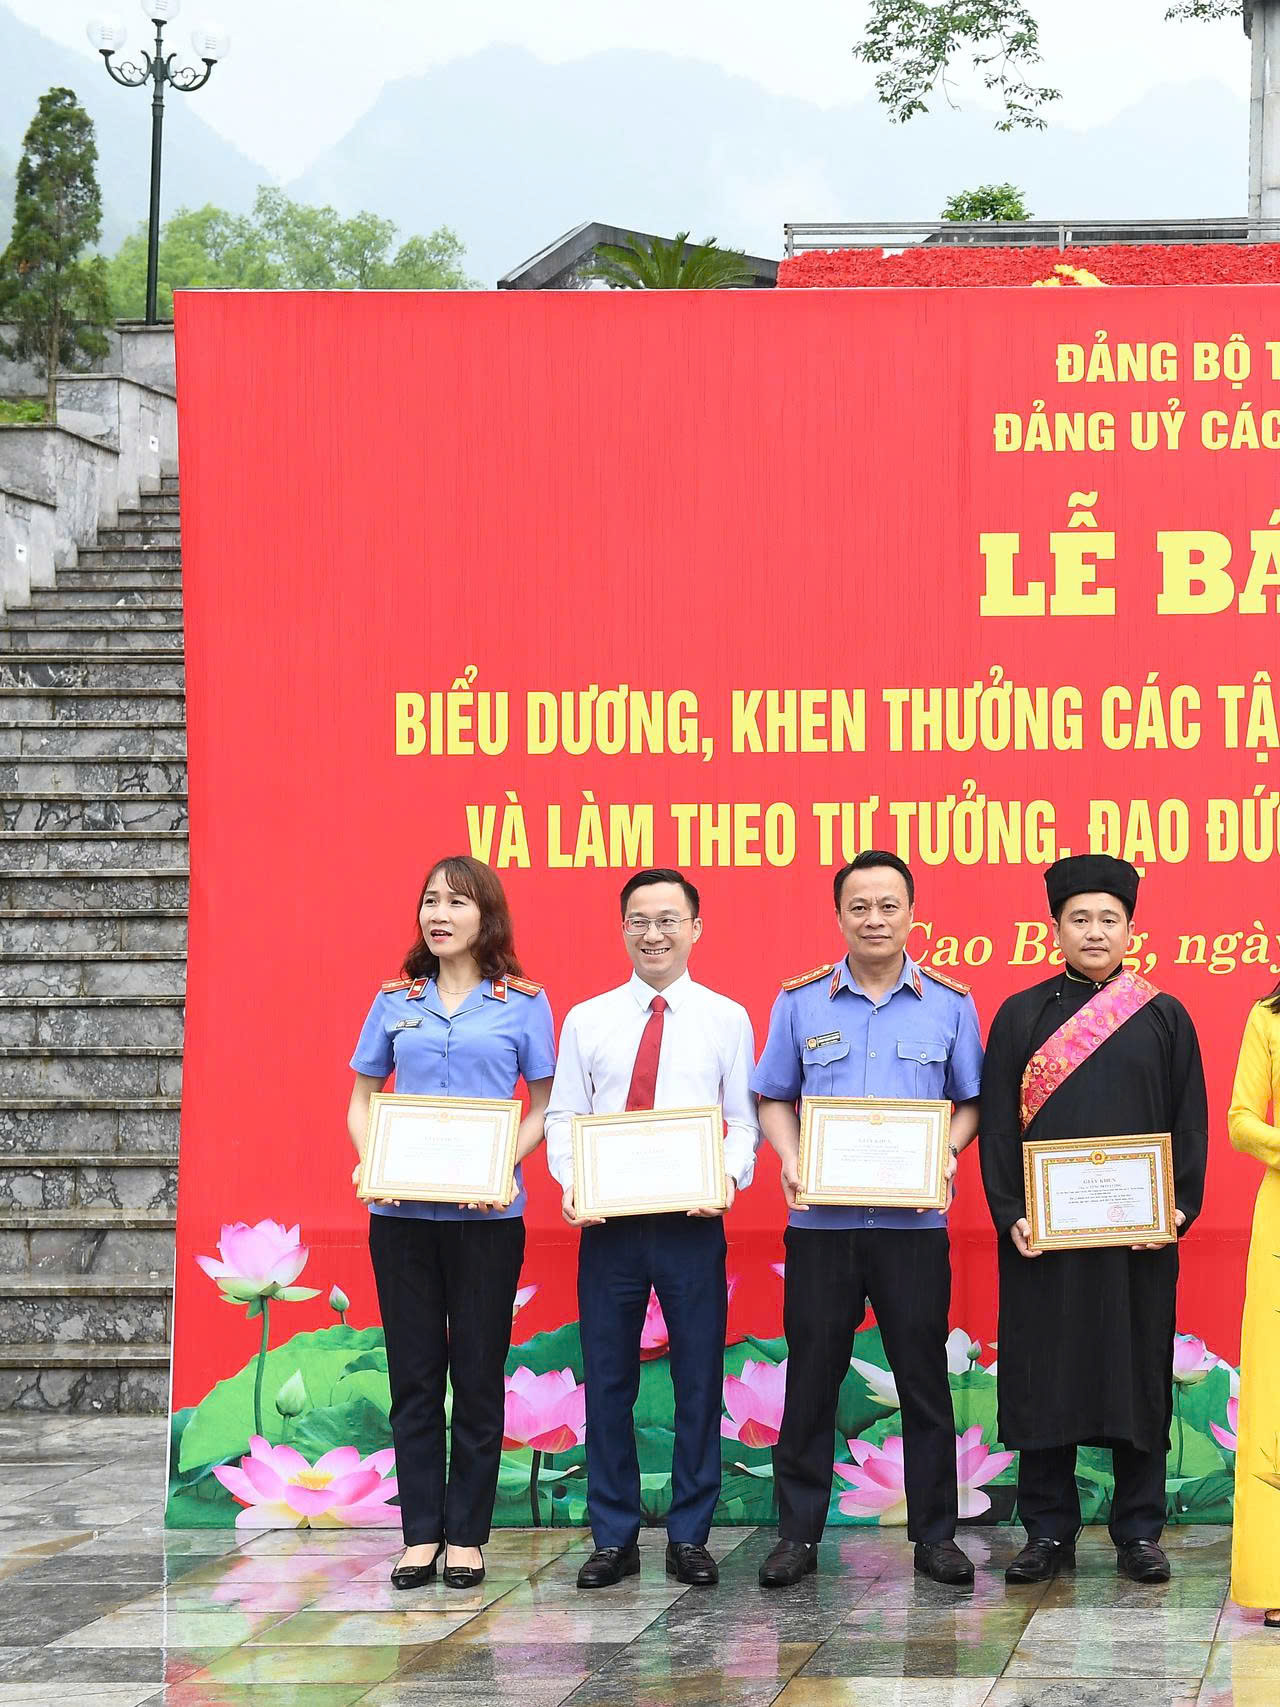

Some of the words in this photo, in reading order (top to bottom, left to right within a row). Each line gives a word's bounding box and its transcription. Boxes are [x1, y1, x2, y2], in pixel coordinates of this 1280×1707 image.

[1056, 330, 1178, 382] ĐẢNG
[1193, 333, 1251, 390] BỘ
[993, 400, 1115, 451] ĐẢNG
[1130, 398, 1187, 450] UỶ
[980, 491, 1116, 616] LỄ
[396, 665, 508, 755] BIỂU
[527, 684, 713, 761] DƯƠNG,
[732, 689, 865, 753] KHEN
[883, 665, 1083, 752] THƯỞNG
[1102, 672, 1200, 750] CÁC
[466, 791, 530, 868] VÀ
[548, 791, 653, 867] LÀM
[671, 802, 795, 866] THEO
[813, 795, 879, 865] TƯ
[1087, 799, 1189, 878] ĐẠO
